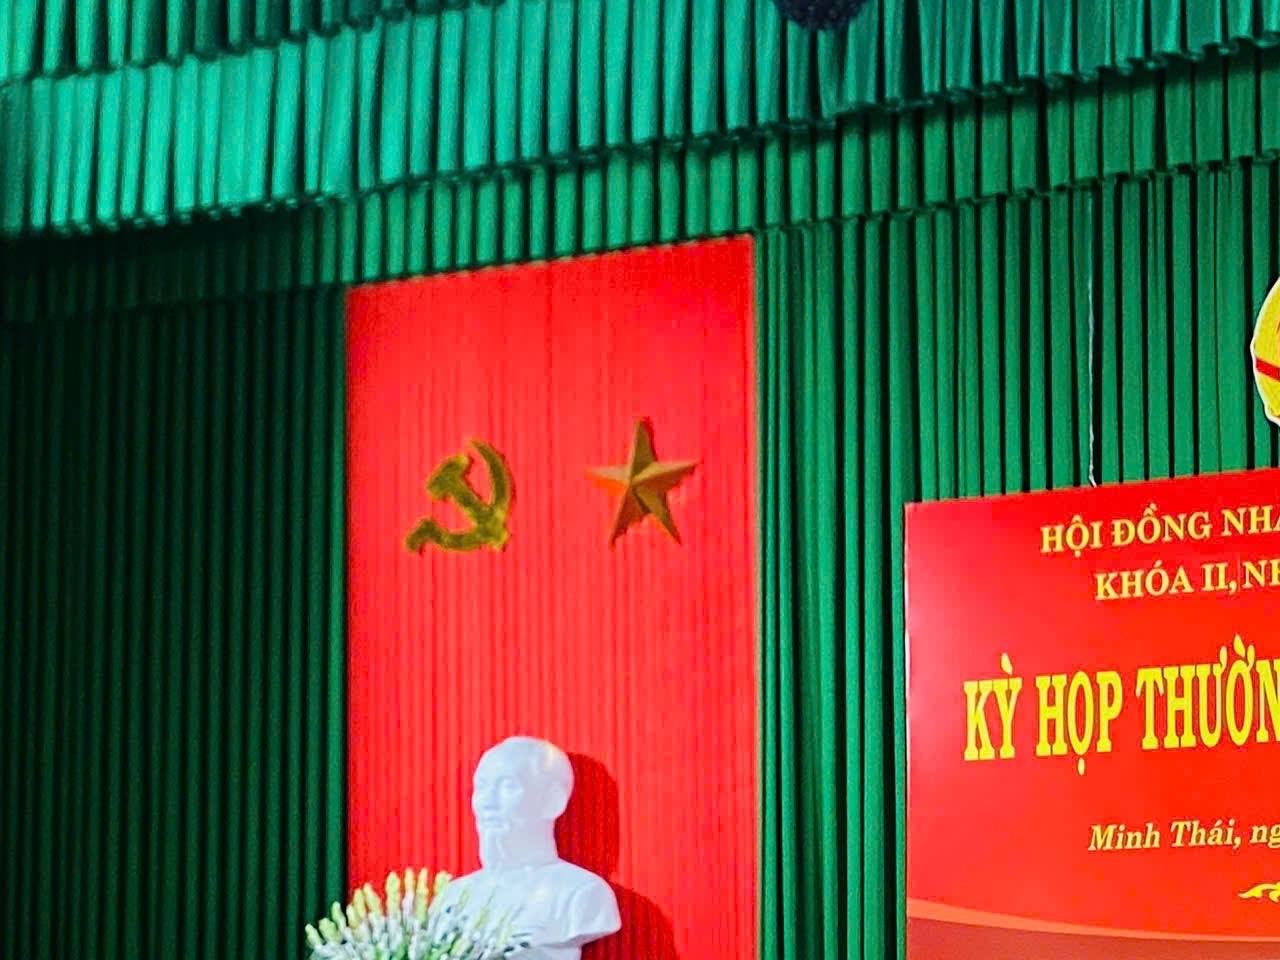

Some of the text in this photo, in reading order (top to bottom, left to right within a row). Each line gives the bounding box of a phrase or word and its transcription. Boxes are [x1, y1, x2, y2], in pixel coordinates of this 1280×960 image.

[1041, 514, 1103, 558] HỘI
[1111, 503, 1212, 546] ĐỒNG
[1095, 559, 1194, 601] KHÓA
[1202, 562, 1237, 594] II,
[963, 652, 1023, 762] KỲ
[1035, 670, 1123, 776] HỌP
[1087, 822, 1161, 851] Minh
[1170, 818, 1242, 849] Thái,
